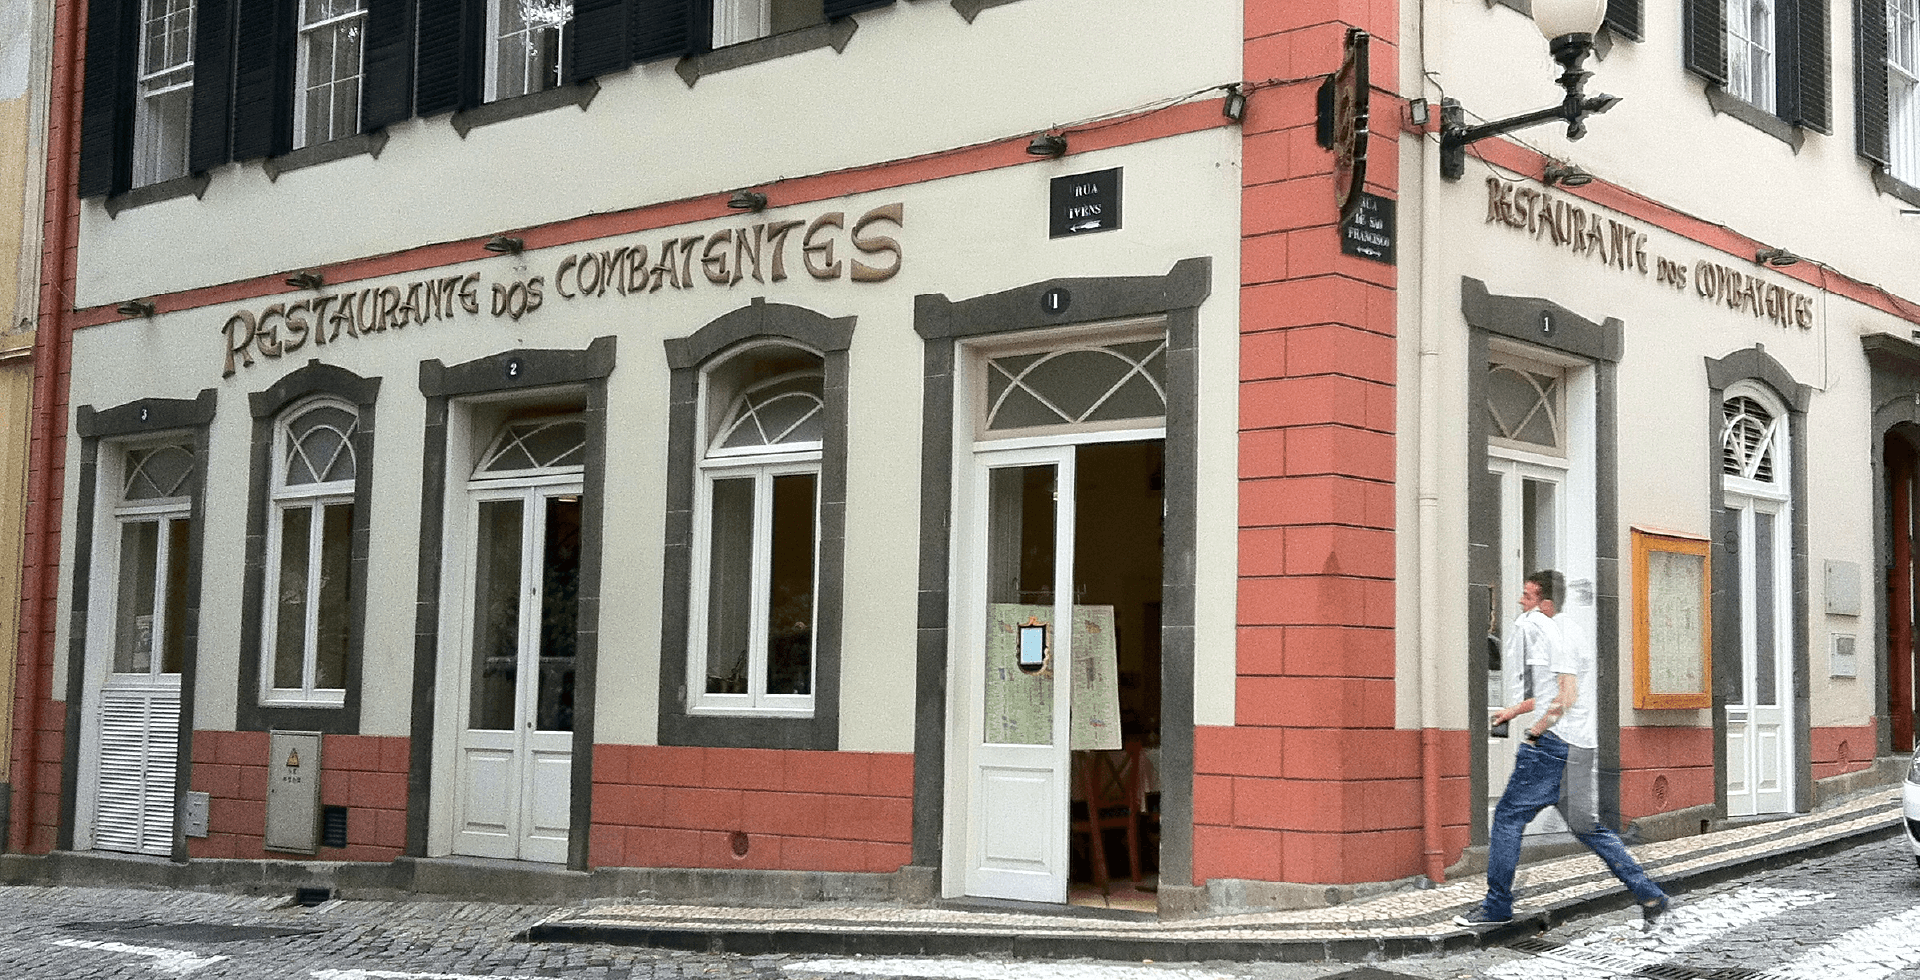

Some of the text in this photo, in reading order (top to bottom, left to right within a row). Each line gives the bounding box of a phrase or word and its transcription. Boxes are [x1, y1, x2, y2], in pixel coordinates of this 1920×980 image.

[1075, 183, 1098, 197] RUA
[1348, 226, 1390, 247] FRANCISCO
[1486, 175, 1813, 330] RESTAURANTE DOS COMBATENTES
[222, 202, 904, 379] RESTAURANTE DOS COMBATENTES
[1544, 316, 1549, 332] 1
[510, 362, 518, 376] 2
[142, 409, 147, 420] 3
